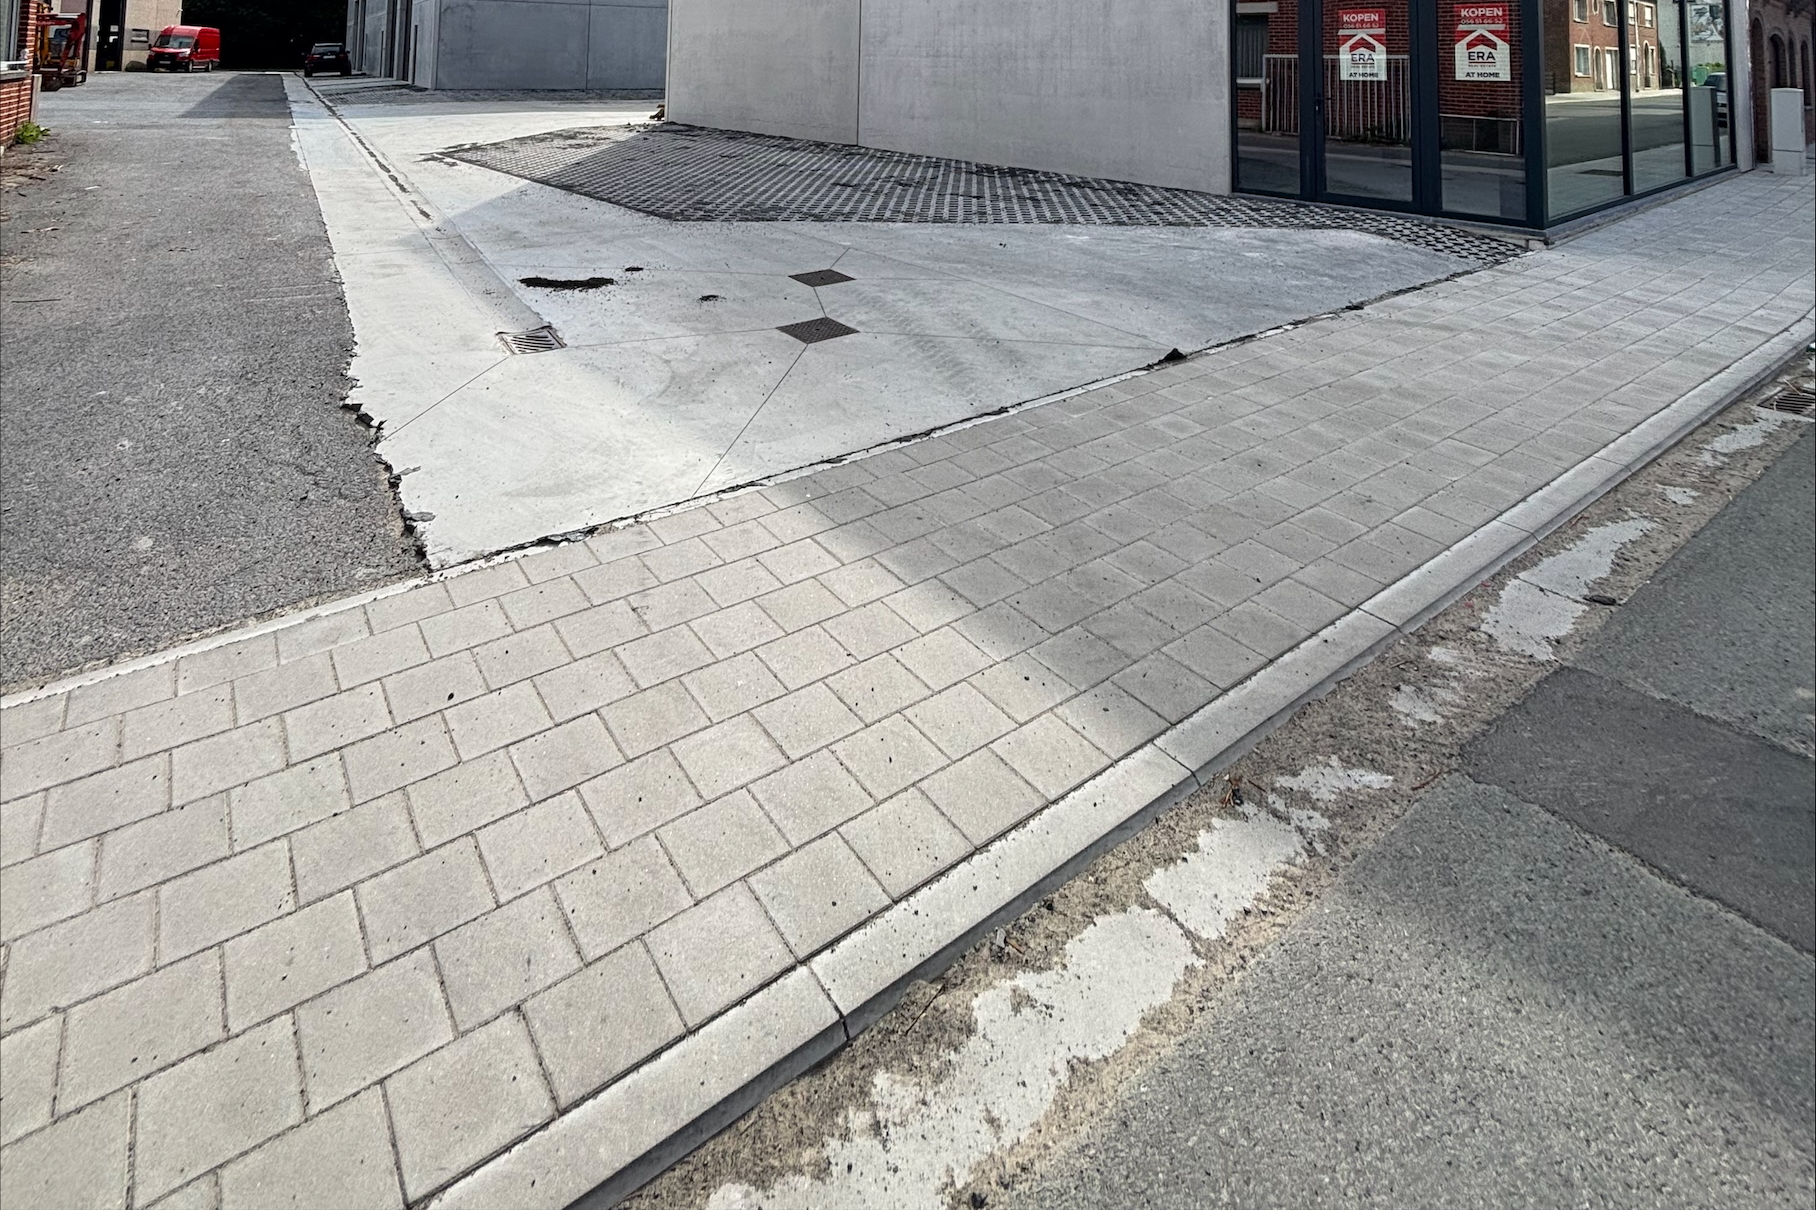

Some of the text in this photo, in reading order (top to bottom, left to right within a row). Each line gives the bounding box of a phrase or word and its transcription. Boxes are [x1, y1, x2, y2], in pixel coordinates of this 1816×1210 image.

[1461, 8, 1503, 17] KOPEN
[1343, 13, 1379, 22] KOPEN
[1351, 53, 1375, 62] ERA
[1468, 51, 1496, 61] ERA
